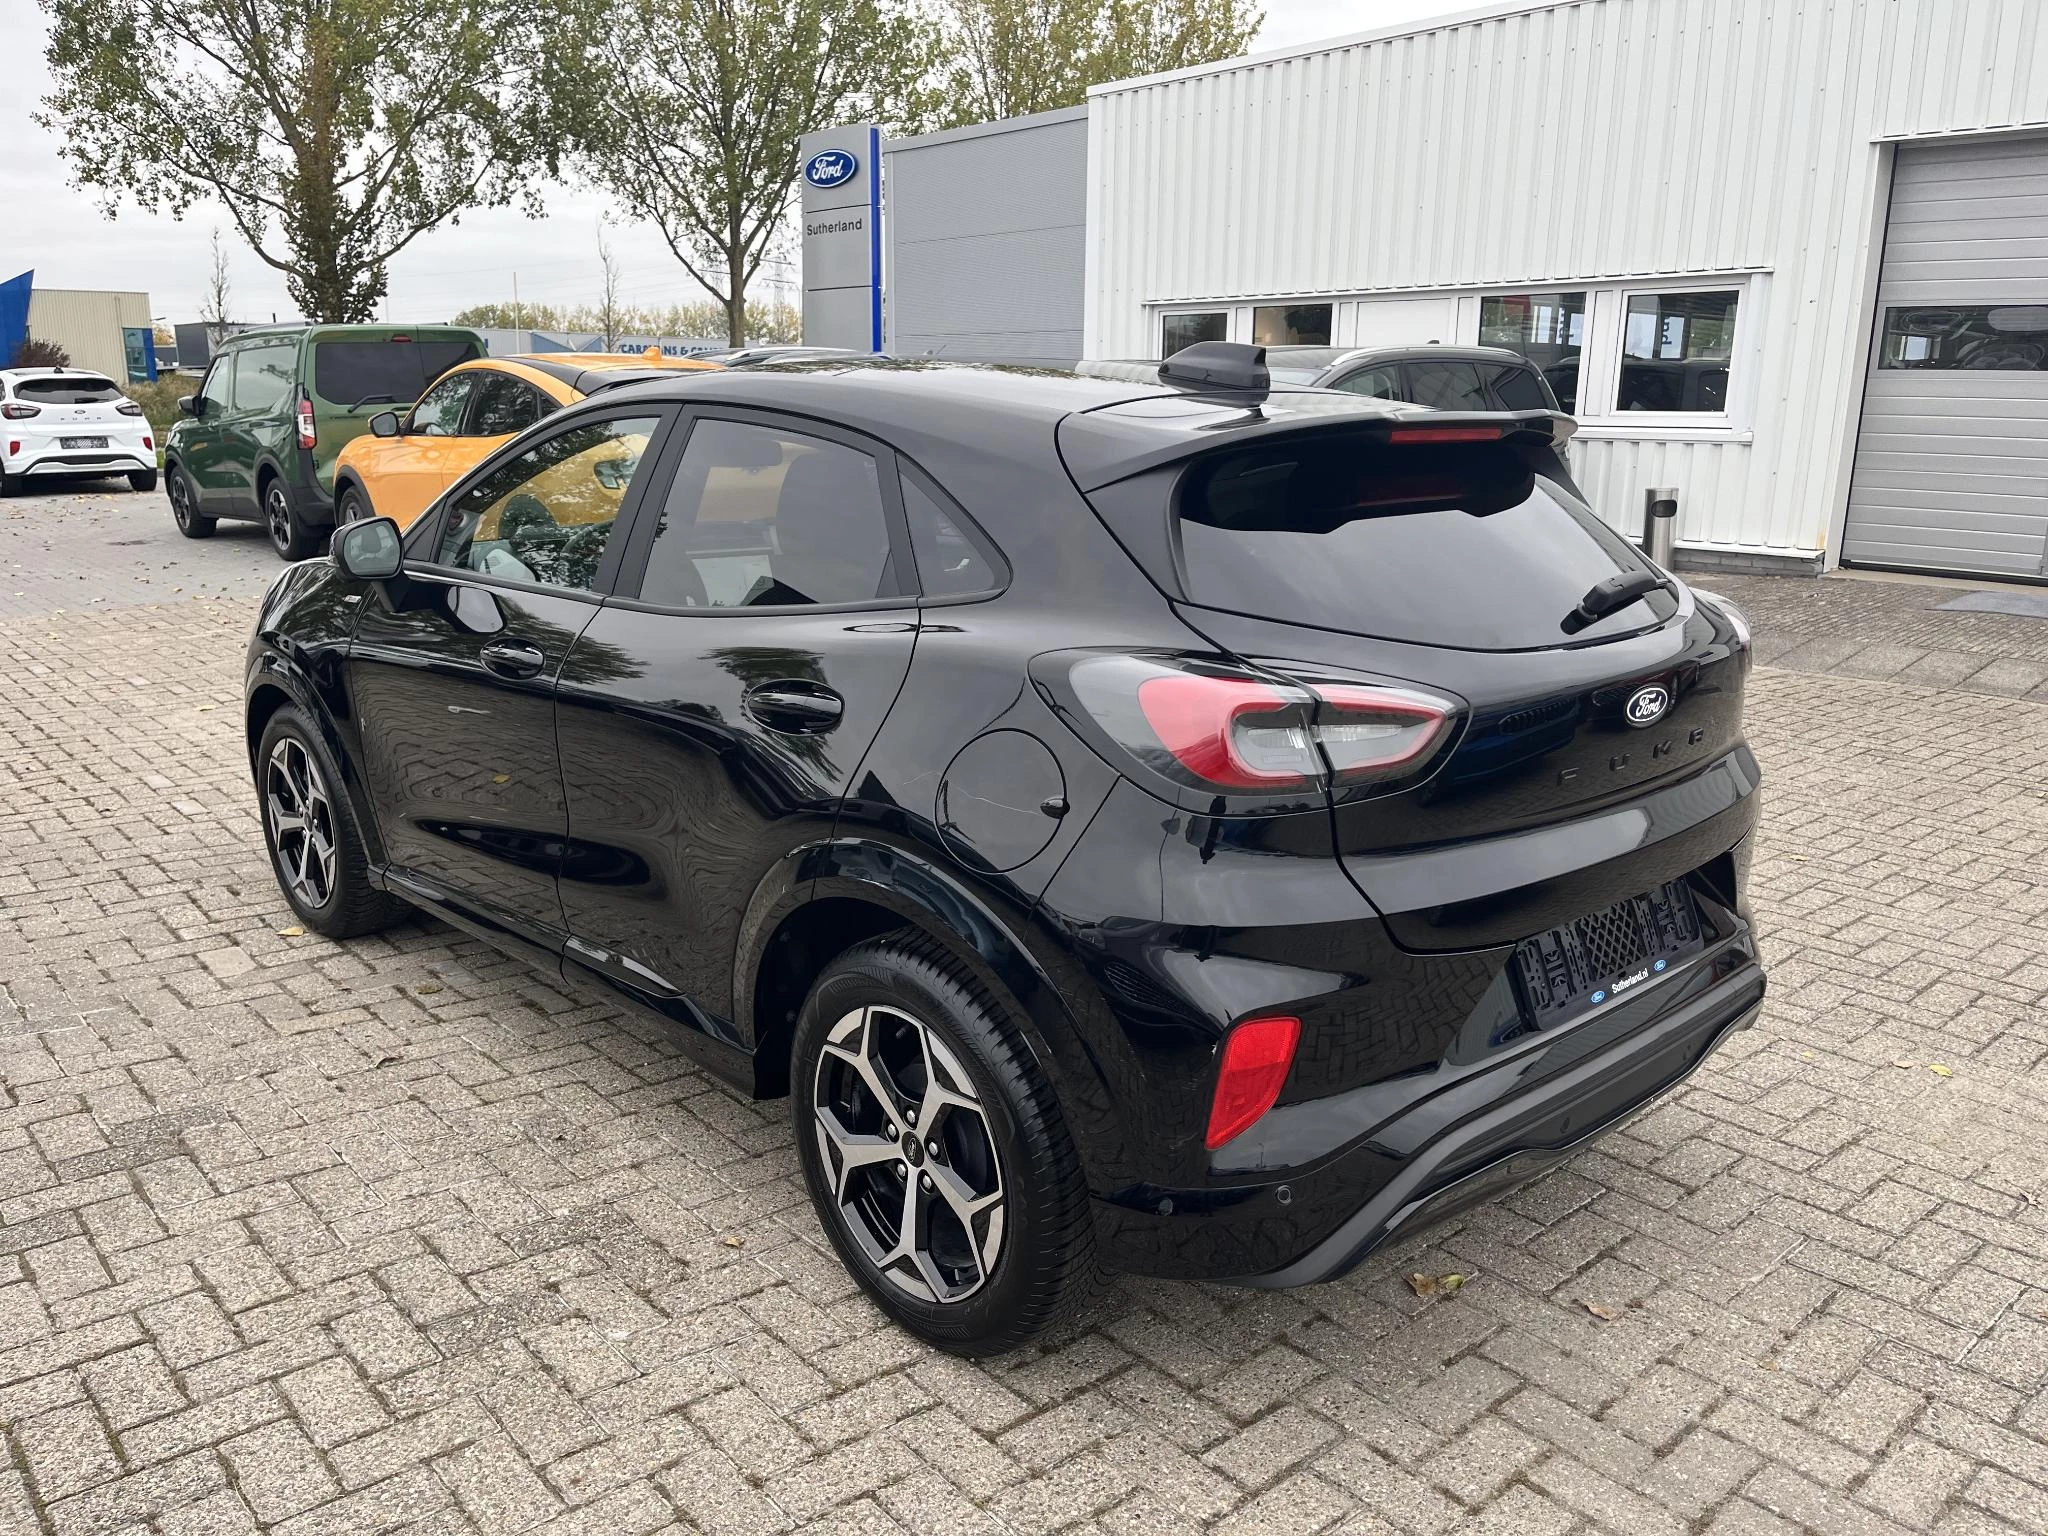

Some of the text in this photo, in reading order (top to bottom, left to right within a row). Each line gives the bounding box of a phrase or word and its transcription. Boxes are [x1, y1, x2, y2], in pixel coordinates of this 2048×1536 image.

[812, 155, 844, 180] Ford
[807, 218, 862, 236] Sutherland
[620, 343, 678, 356] CARNS
[1635, 692, 1662, 718] Ford
[1611, 967, 1649, 994] Sutherland.nl
